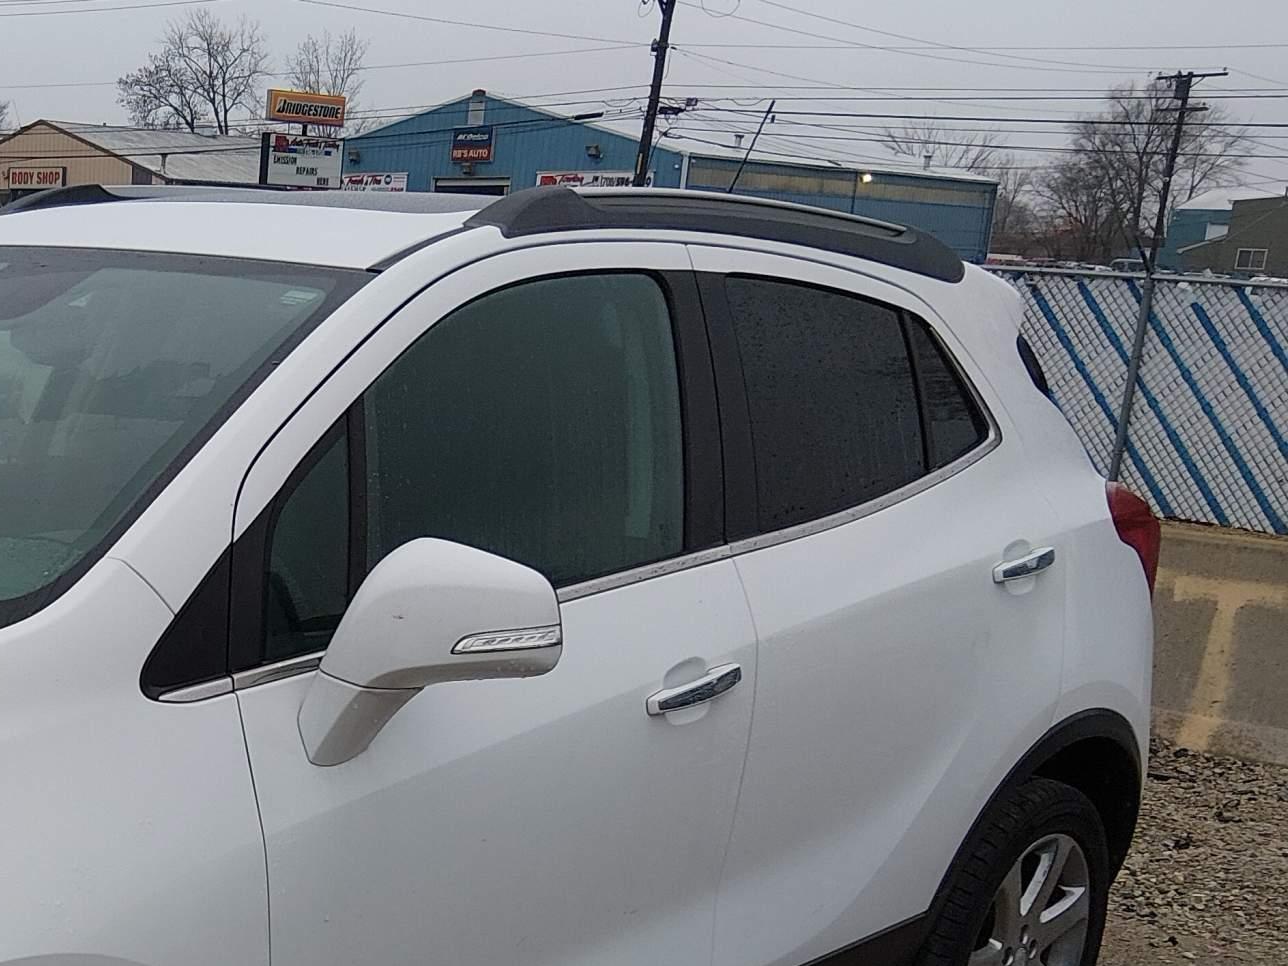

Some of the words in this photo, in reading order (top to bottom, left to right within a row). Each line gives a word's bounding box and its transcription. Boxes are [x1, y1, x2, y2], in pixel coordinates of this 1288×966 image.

[276, 99, 342, 119] BRIDGESTONE
[469, 149, 488, 158] AUTO
[273, 154, 297, 165] EMISSION
[296, 167, 319, 176] REPAIRS
[12, 171, 34, 185] BODY
[36, 171, 61, 185] SHOP
